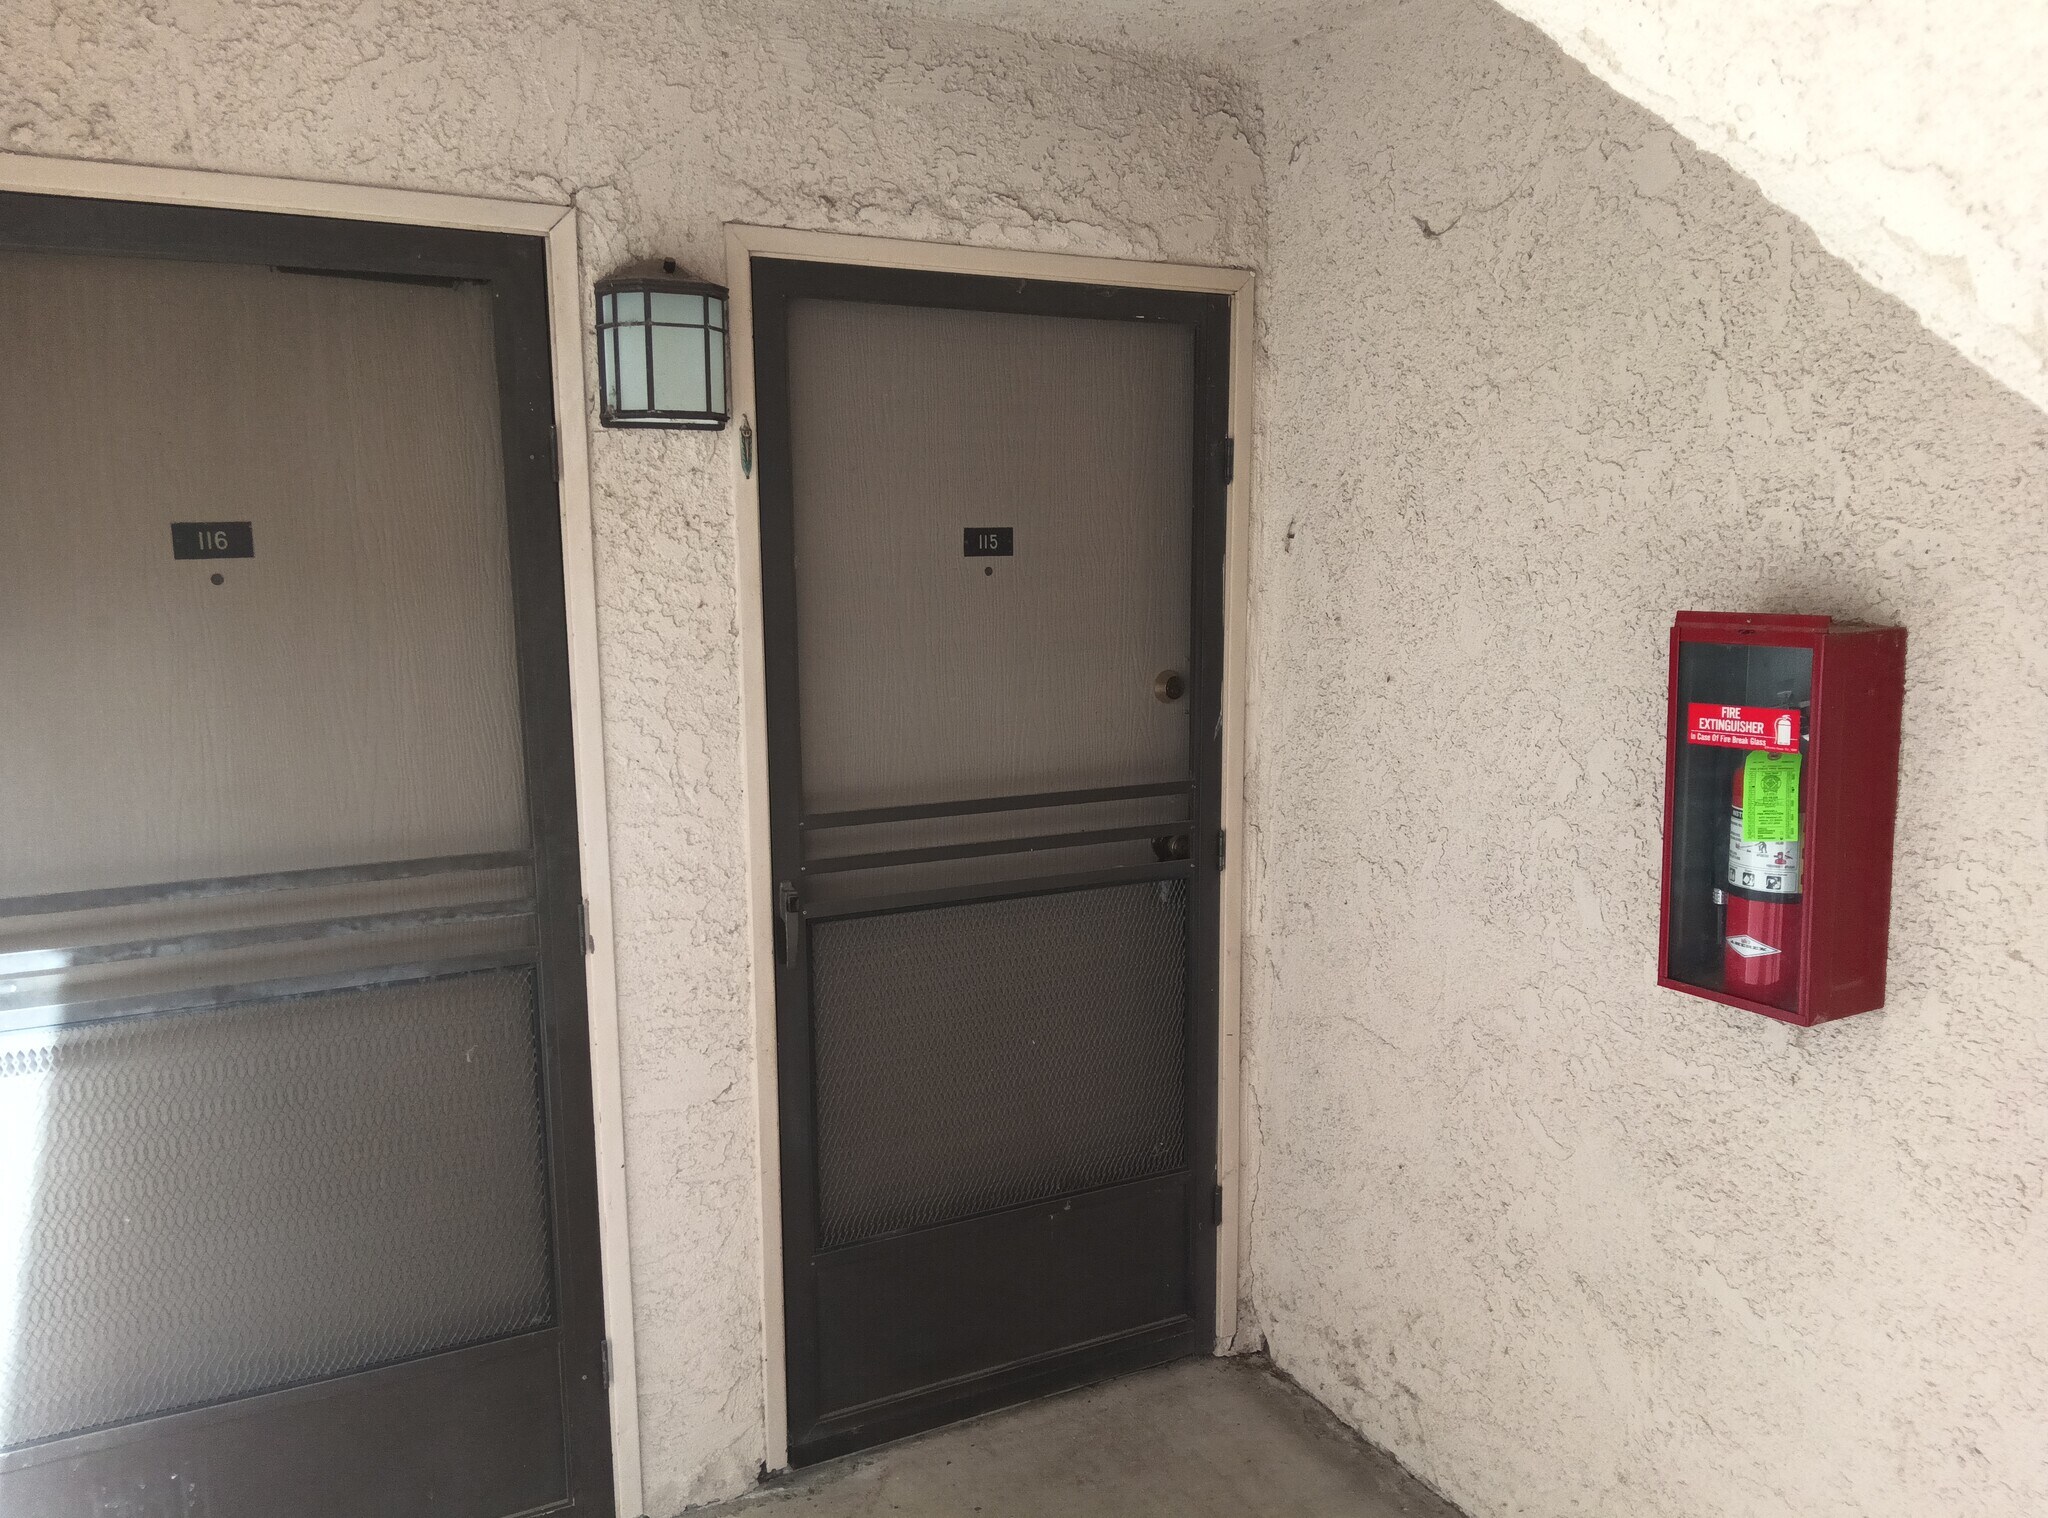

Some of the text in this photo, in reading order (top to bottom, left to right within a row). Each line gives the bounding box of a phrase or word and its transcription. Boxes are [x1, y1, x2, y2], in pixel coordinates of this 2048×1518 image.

[198, 530, 228, 550] 116
[979, 534, 998, 549] 115
[1721, 706, 1741, 719] FIRE
[1699, 718, 1764, 734] EXTINGUISHER
[1697, 733, 1711, 741] Case
[1712, 734, 1719, 742] Of
[1720, 735, 1731, 743] Fire
[1732, 736, 1748, 745] Break
[1750, 737, 1766, 746] Glass
